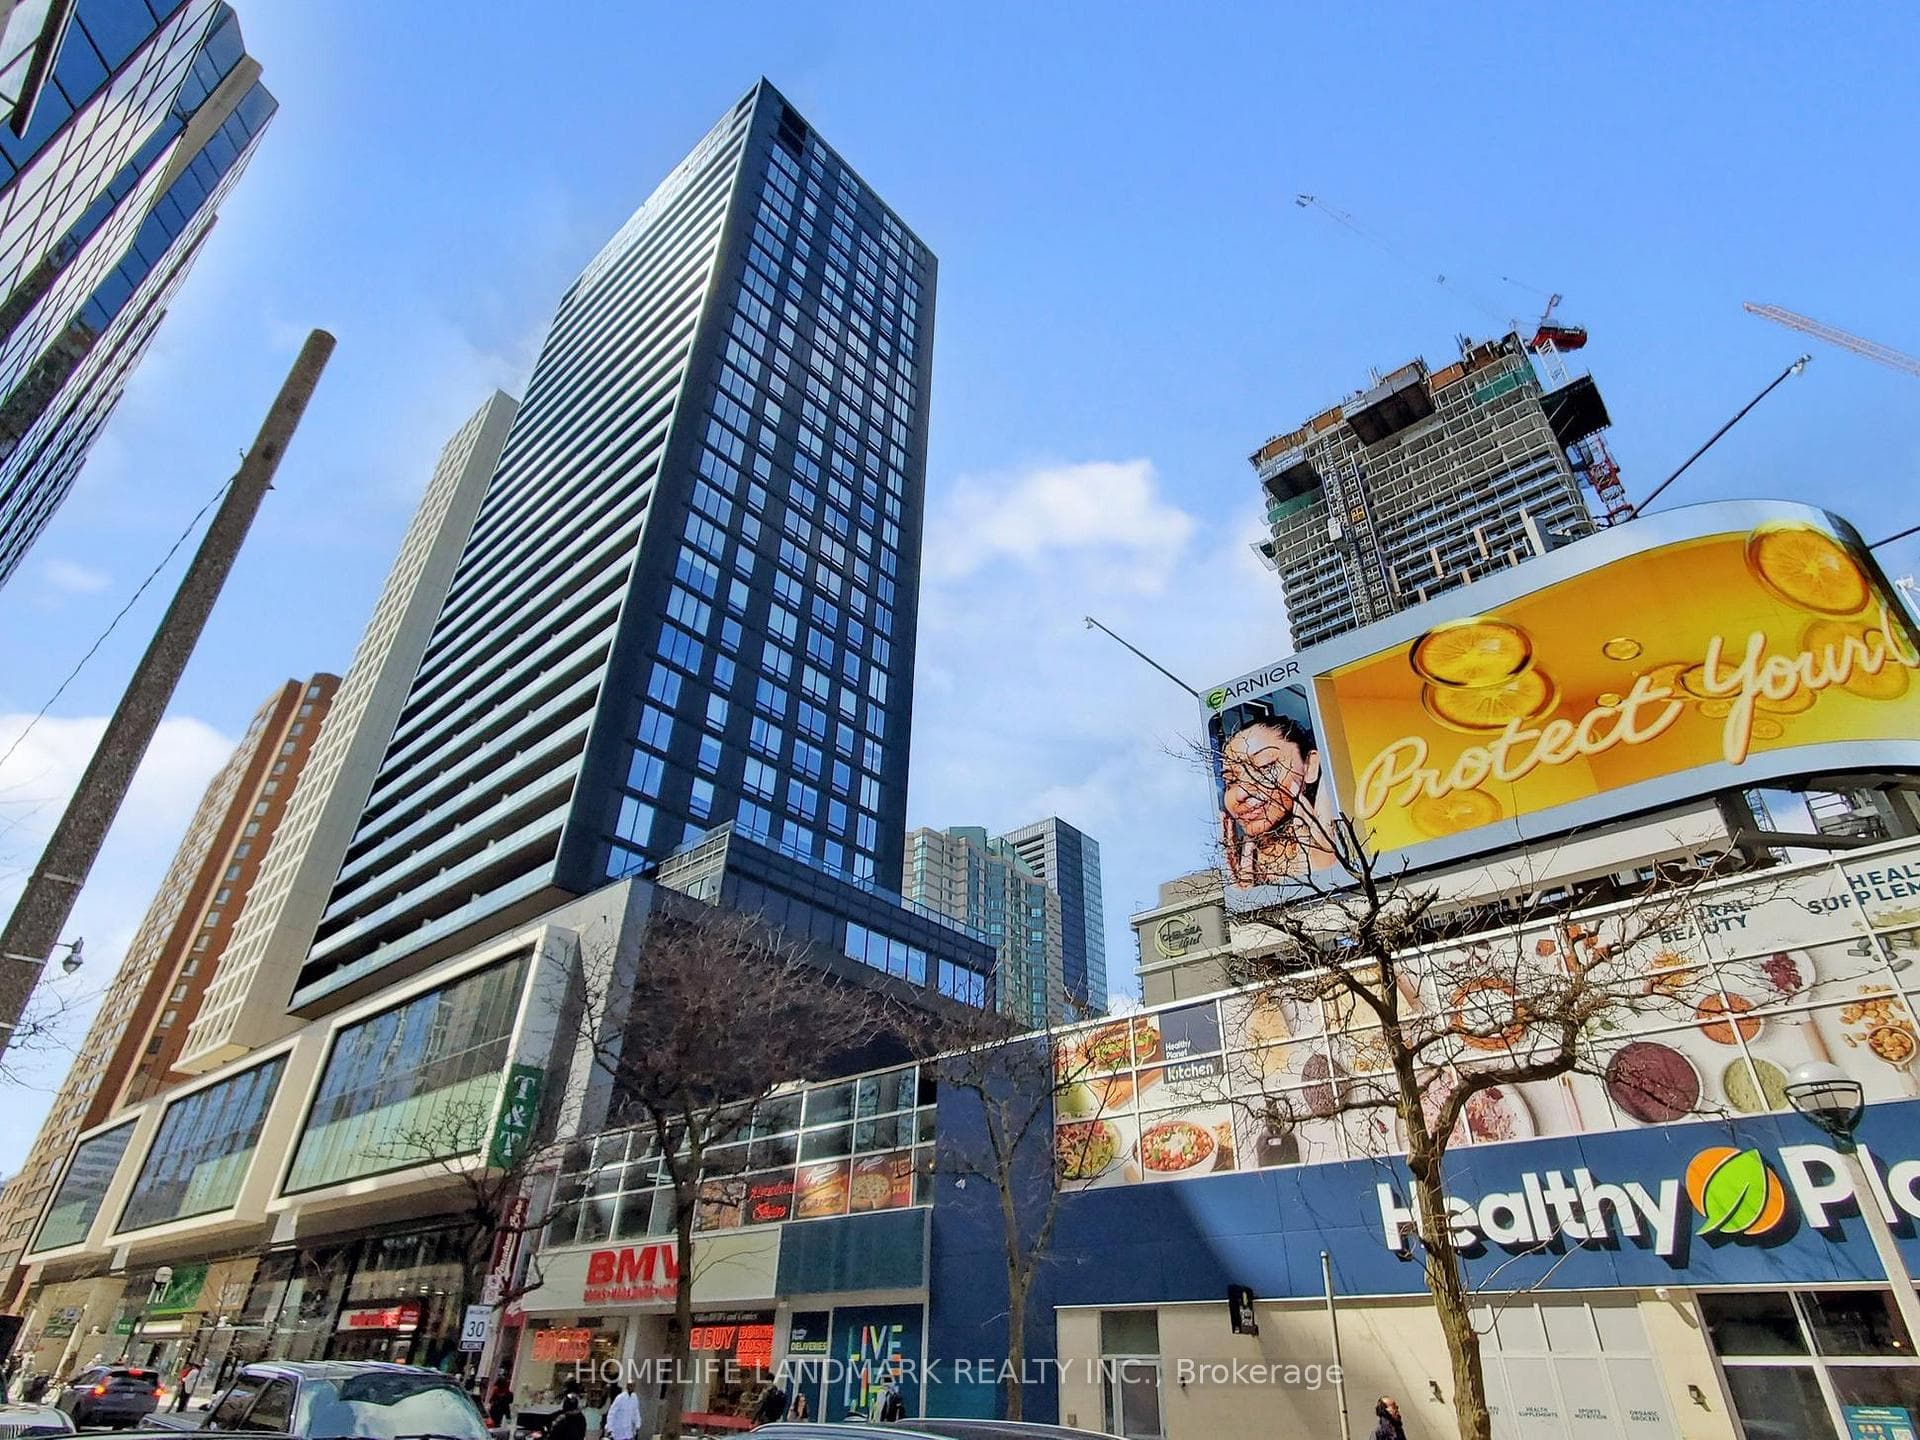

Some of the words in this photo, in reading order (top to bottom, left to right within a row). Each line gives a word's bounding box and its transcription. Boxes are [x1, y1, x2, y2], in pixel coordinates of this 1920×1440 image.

[1354, 673, 1684, 820] Protect
[1165, 1039, 1191, 1052] Healthy
[1166, 1049, 1187, 1060] Planet
[1167, 1062, 1214, 1081] kitchen
[1376, 1166, 1680, 1257] Healthy
[467, 1320, 485, 1338] 30
[703, 1326, 736, 1350] BUY
[791, 1341, 828, 1352] DELIVERIES
